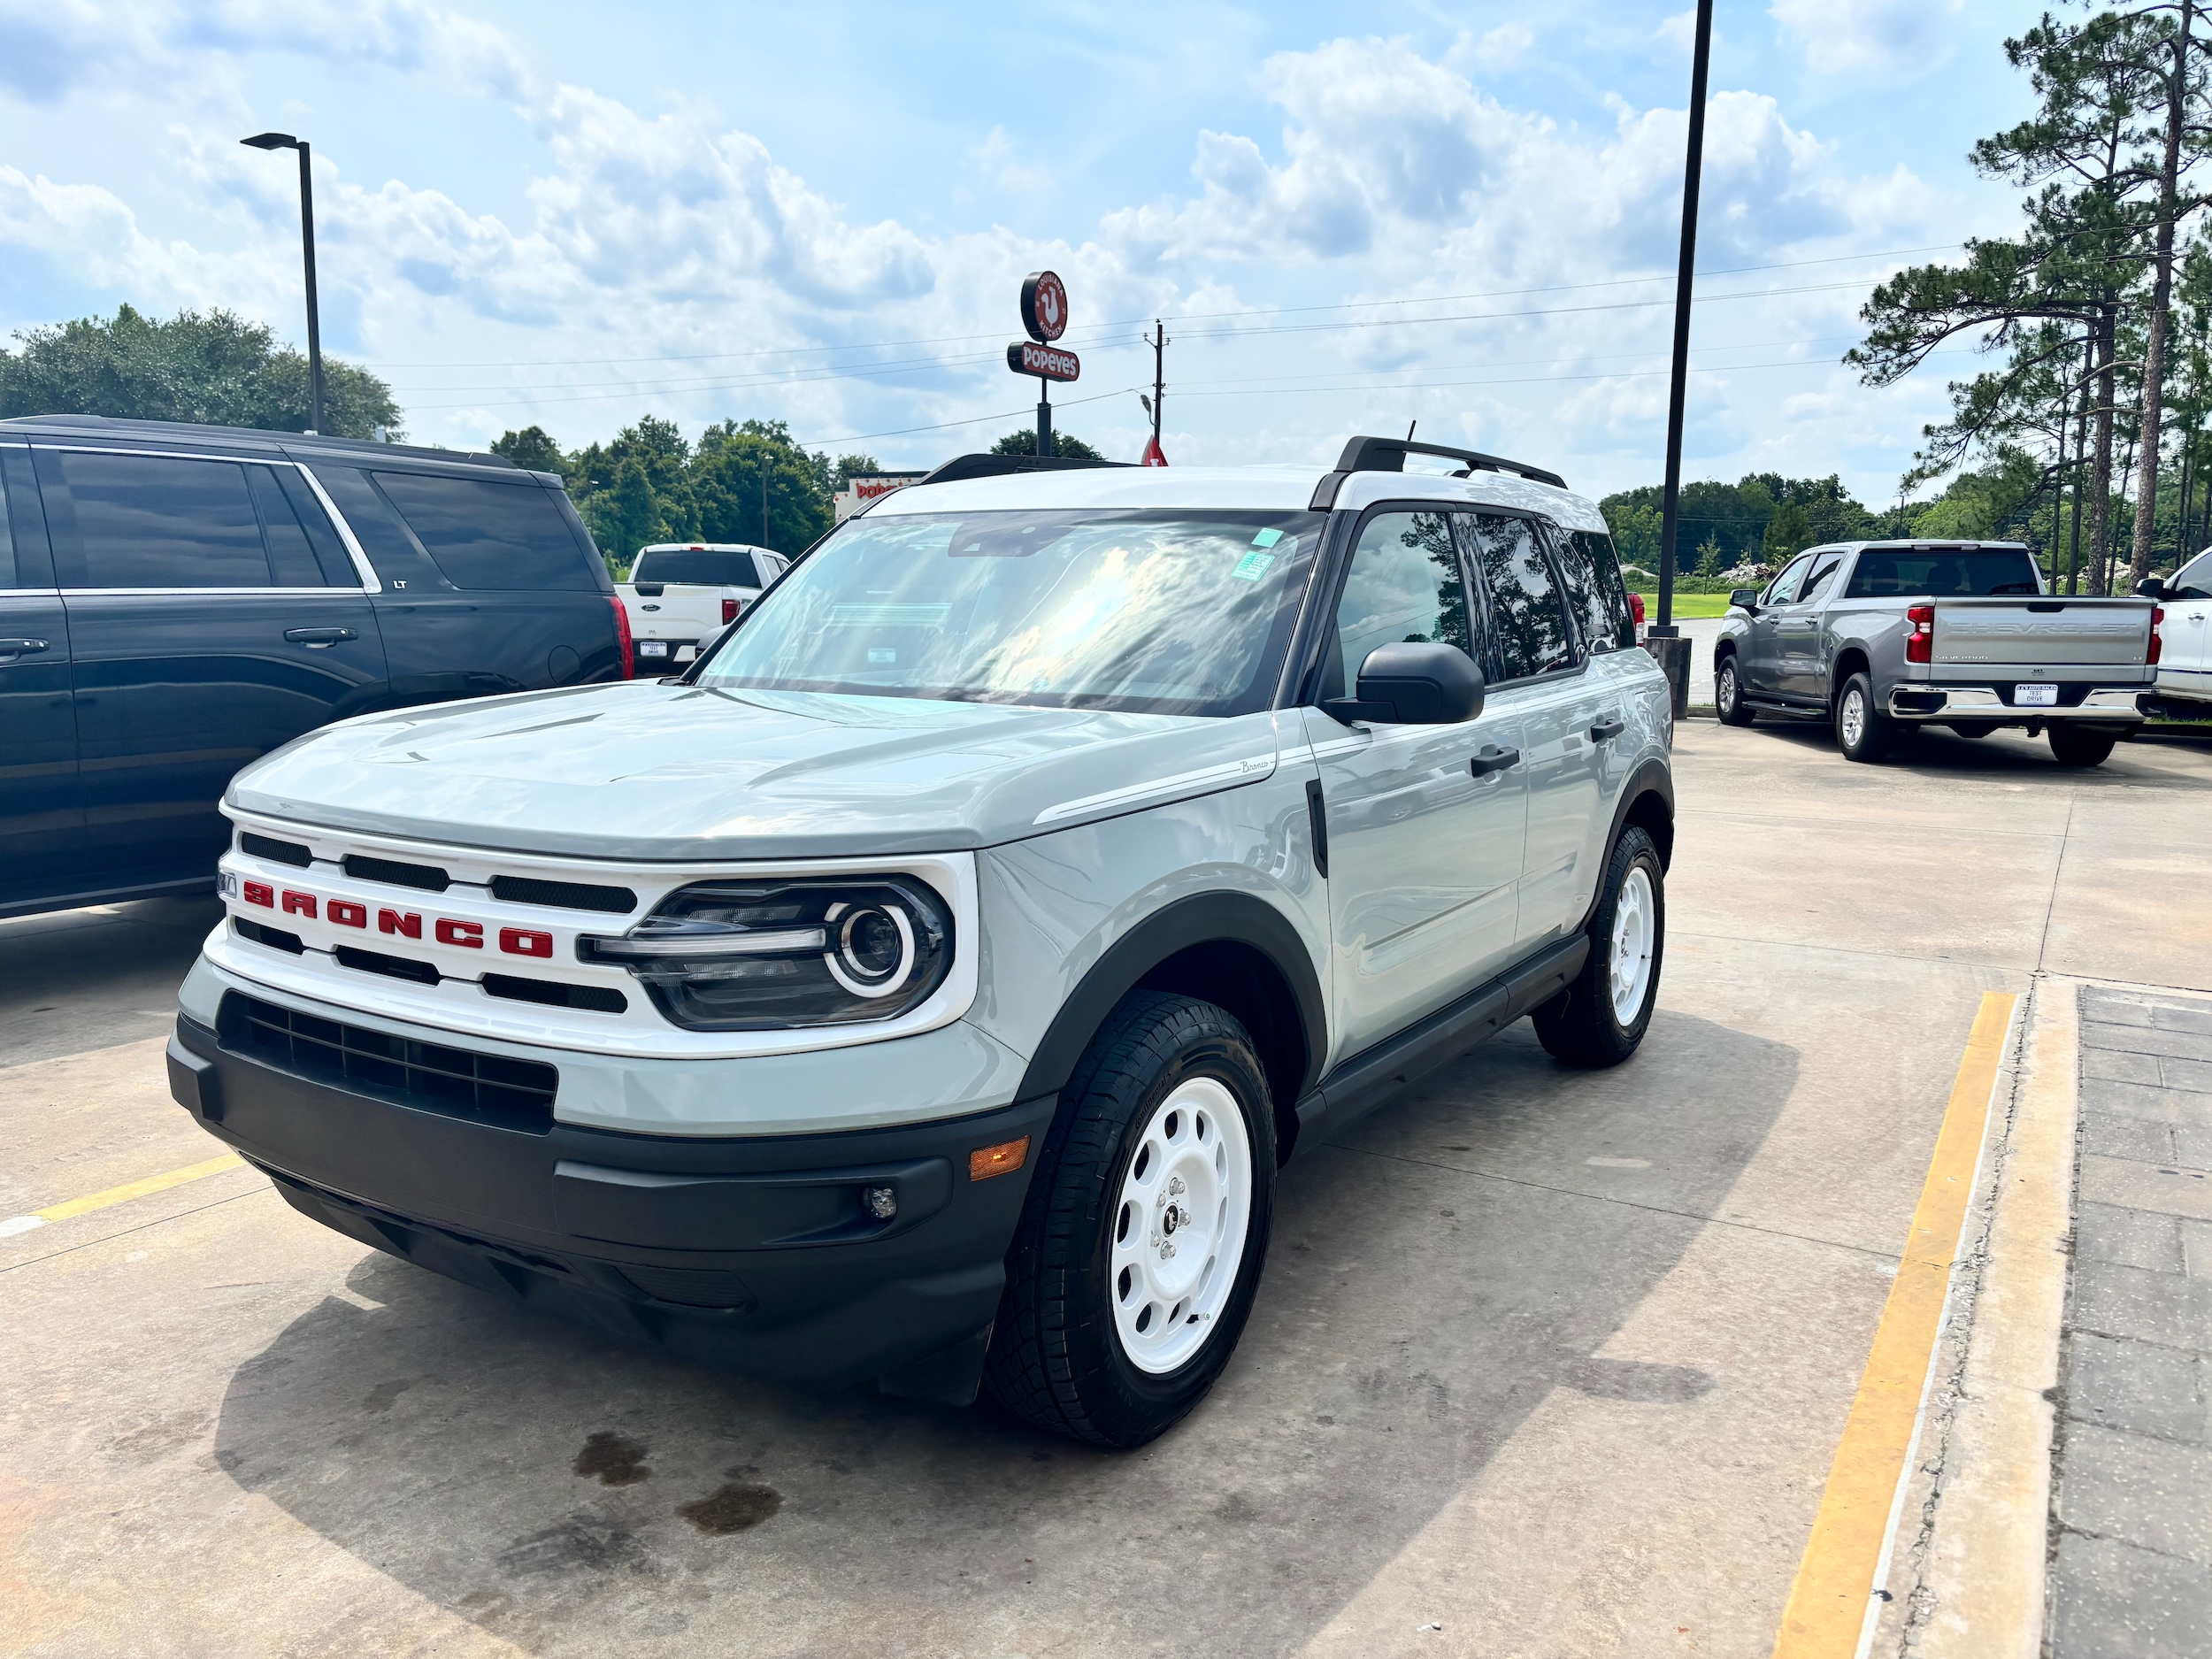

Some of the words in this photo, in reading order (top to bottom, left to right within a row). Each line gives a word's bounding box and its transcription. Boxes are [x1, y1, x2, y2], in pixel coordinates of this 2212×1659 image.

[1038, 274, 1064, 297] LOUISIANA
[1039, 319, 1063, 338] KITCHEN
[1024, 346, 1077, 376] POPEYES
[393, 580, 407, 589] LT
[1949, 622, 2138, 635] CHEVROLET
[1240, 760, 1269, 772] Bronco
[243, 879, 553, 958] BRONCO
